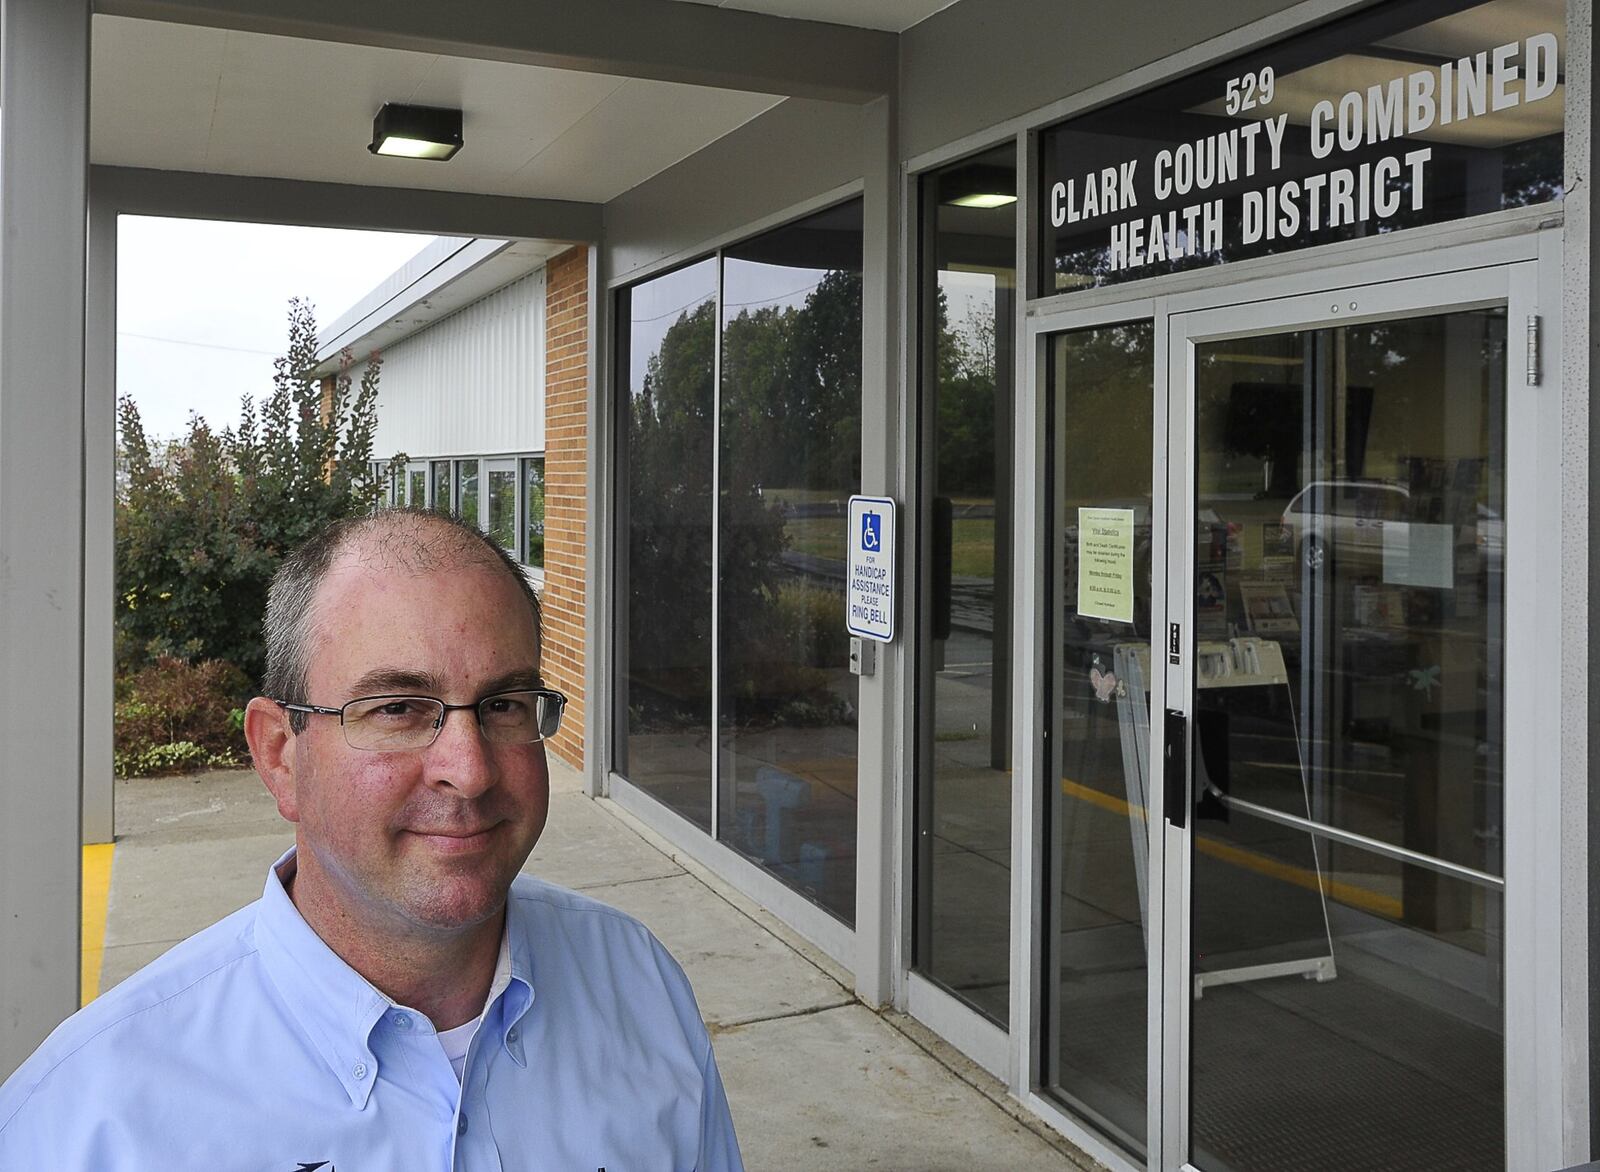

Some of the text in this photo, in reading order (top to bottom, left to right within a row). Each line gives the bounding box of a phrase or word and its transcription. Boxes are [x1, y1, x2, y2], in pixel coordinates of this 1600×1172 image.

[1225, 66, 1276, 117] 529
[1051, 32, 1559, 228] CLARK COUNTY COMBINED
[1110, 147, 1432, 272] HEALTH DISTRICT
[866, 555, 875, 564] FOR
[855, 564, 887, 580] HANDICAP
[852, 579, 889, 597] ASSISTANCE
[861, 595, 879, 607] PLEASE
[852, 604, 887, 625] RING BELL
